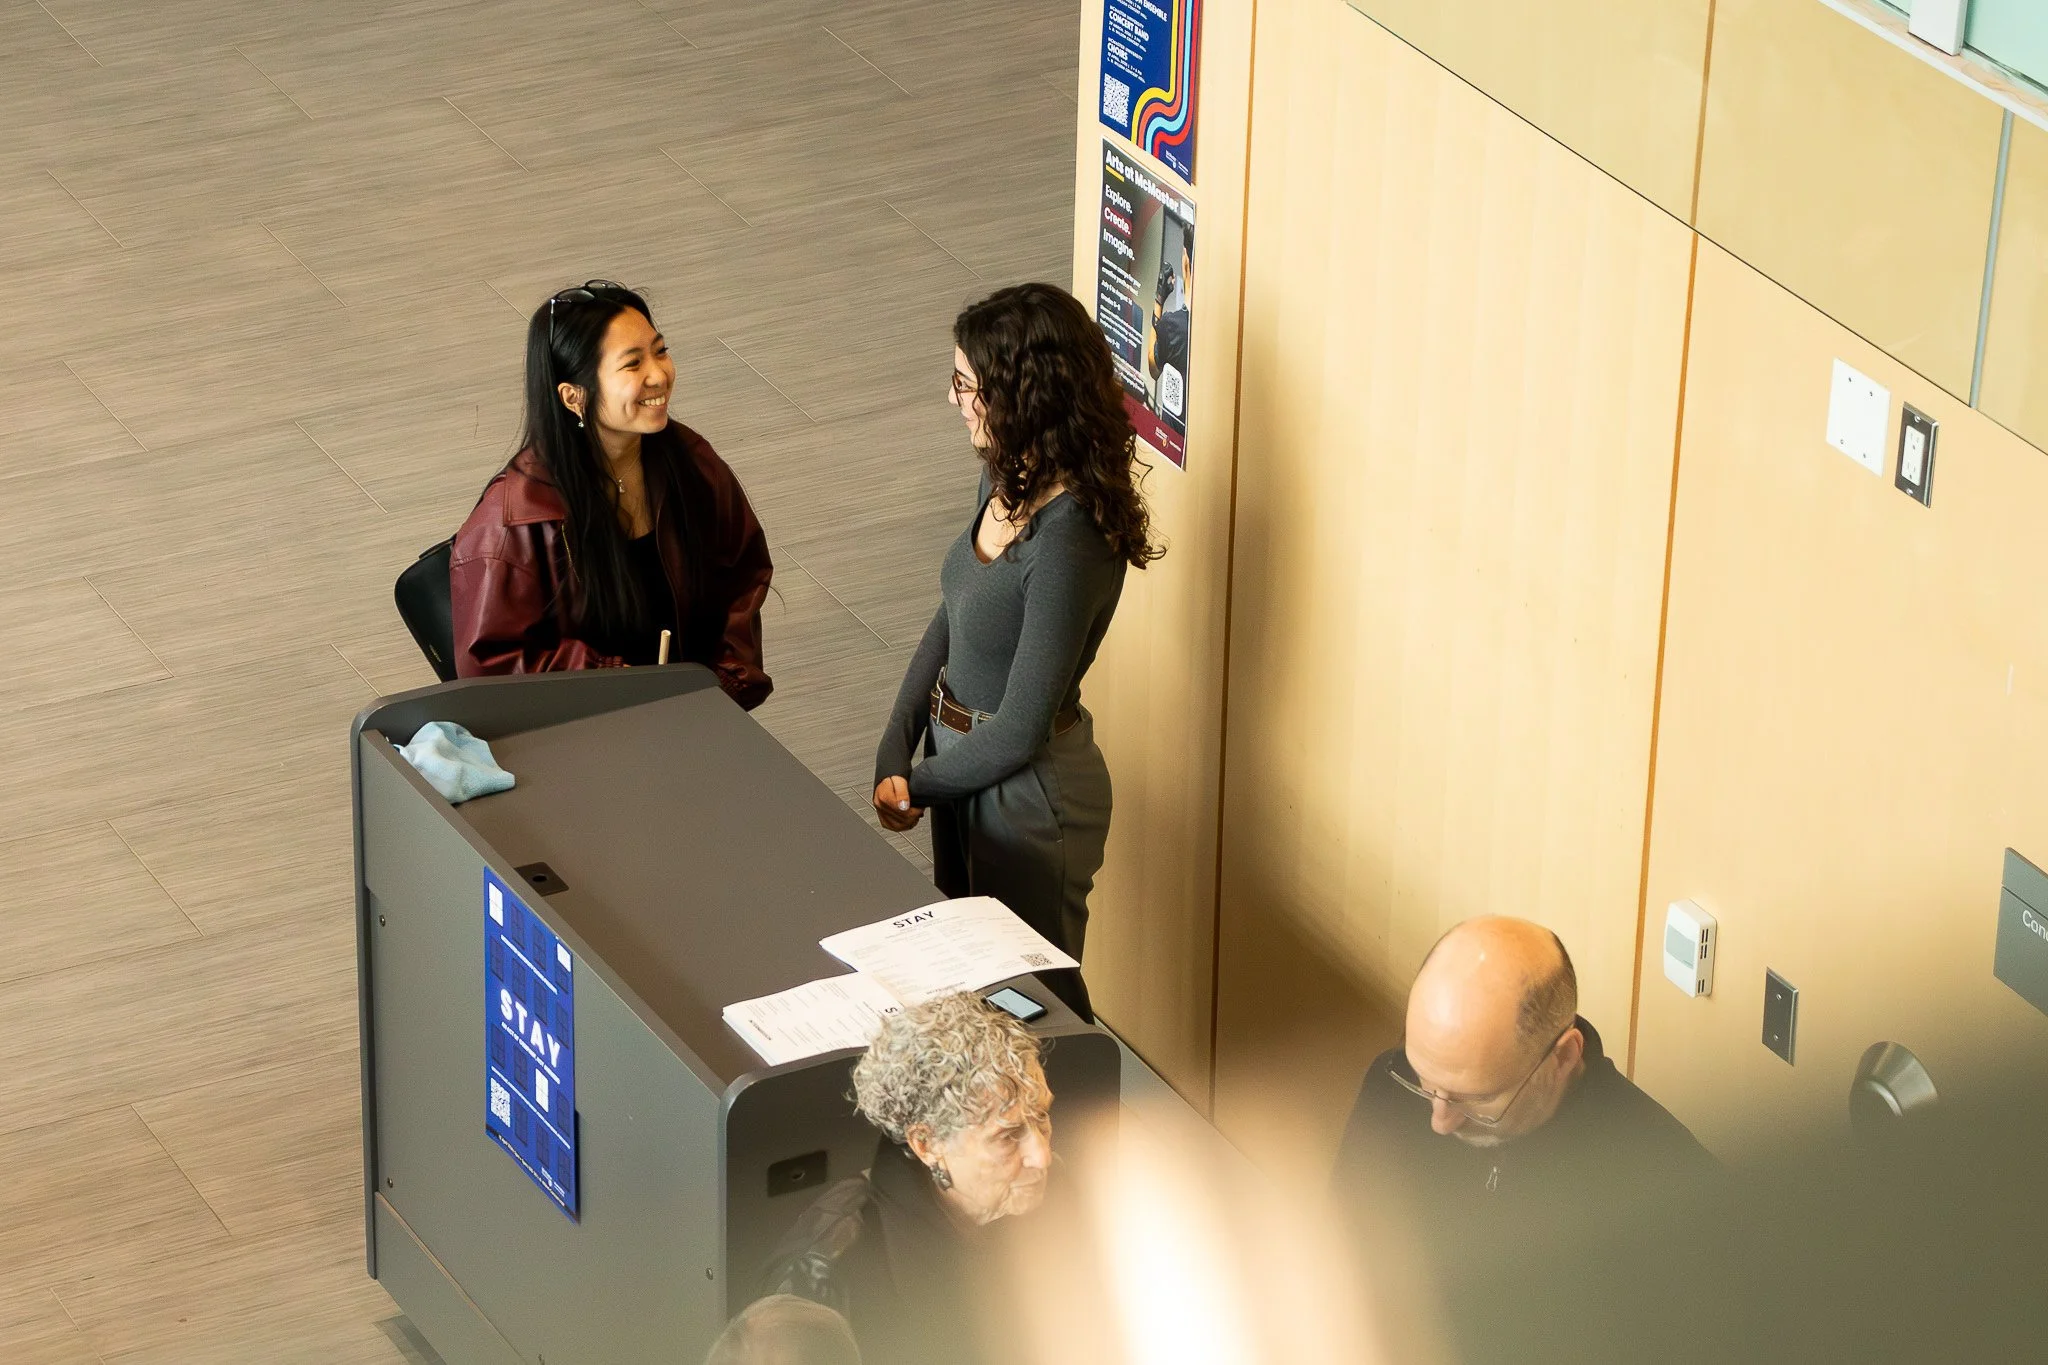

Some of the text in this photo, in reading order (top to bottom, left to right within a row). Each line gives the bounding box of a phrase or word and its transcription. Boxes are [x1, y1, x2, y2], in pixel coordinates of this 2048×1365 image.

[1108, 10, 1135, 32] CONCERT
[1134, 25, 1150, 42] BAND
[1107, 42, 1129, 61] CHOIRS
[1105, 149, 1125, 175] Arts
[1124, 163, 1135, 183] at
[1134, 169, 1180, 213] McMaster
[1105, 184, 1133, 214] Explore.
[1104, 207, 1132, 235] Create.
[1103, 228, 1136, 261] Imagine.
[892, 910, 934, 929] STAY
[500, 988, 561, 1069] STAY
